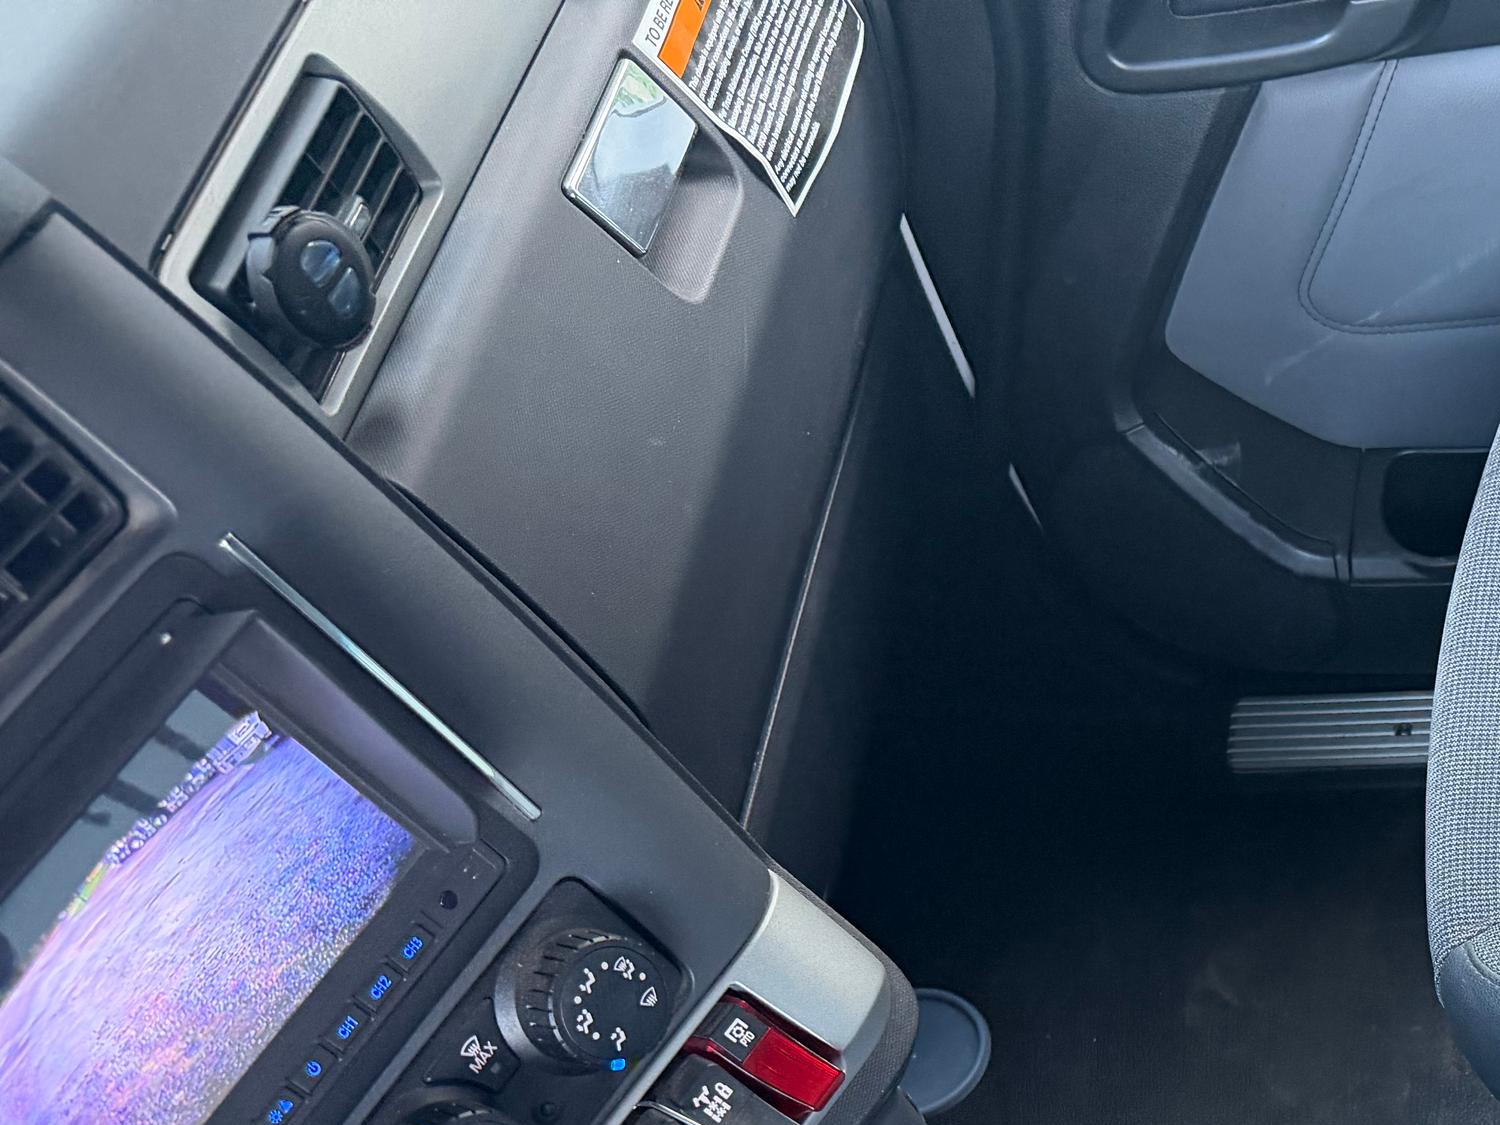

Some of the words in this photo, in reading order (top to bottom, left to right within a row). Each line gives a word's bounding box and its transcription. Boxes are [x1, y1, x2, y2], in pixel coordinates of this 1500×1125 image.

[645, 27, 660, 47] TO
[653, 9, 668, 30] BE
[403, 936, 423, 959] CH3
[370, 975, 392, 1000] CH2
[337, 1015, 359, 1039] CH1
[740, 1031, 756, 1047] PTO
[469, 1041, 498, 1074] MAX
